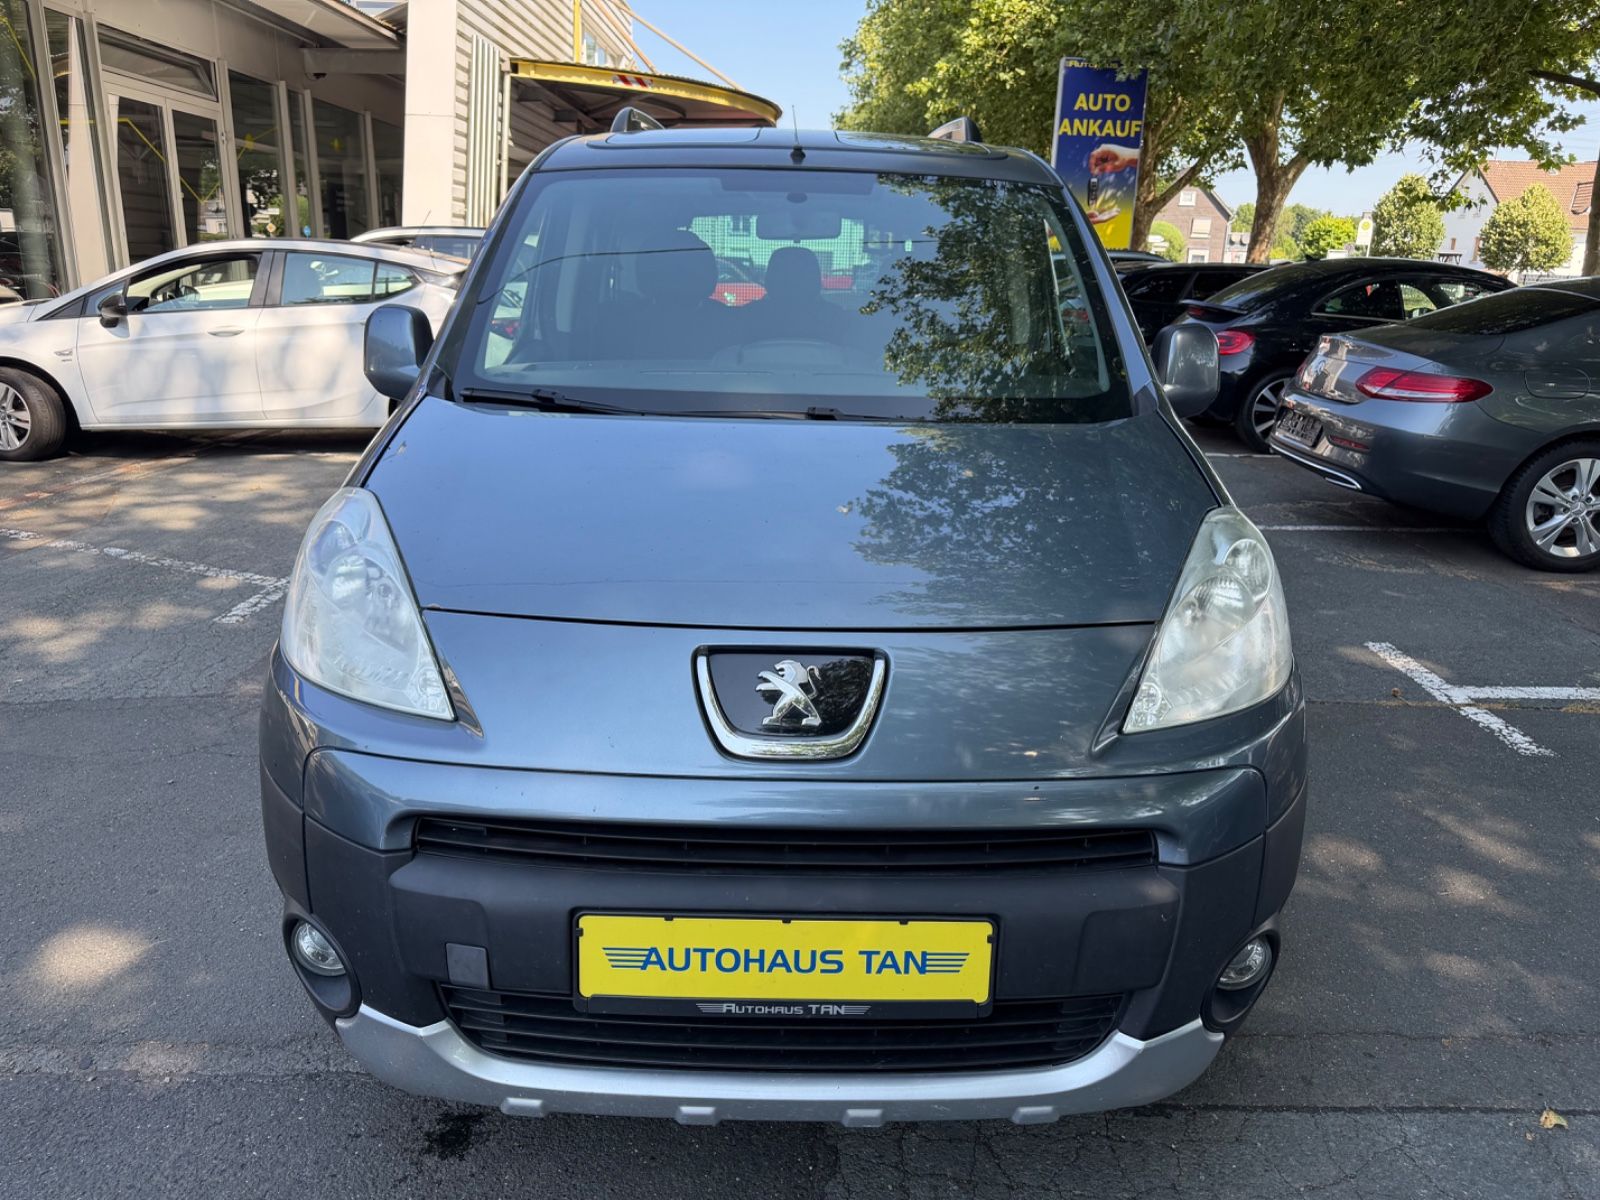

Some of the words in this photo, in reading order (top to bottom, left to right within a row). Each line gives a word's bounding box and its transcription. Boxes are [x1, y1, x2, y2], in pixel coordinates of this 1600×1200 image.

[1073, 93, 1131, 112] AUTO
[1058, 118, 1143, 137] ANKAUF
[641, 946, 843, 974] AUTOHAUS
[859, 949, 928, 975] TAN
[722, 1003, 804, 1015] AUTOHAUS
[808, 1004, 845, 1016] TAN
